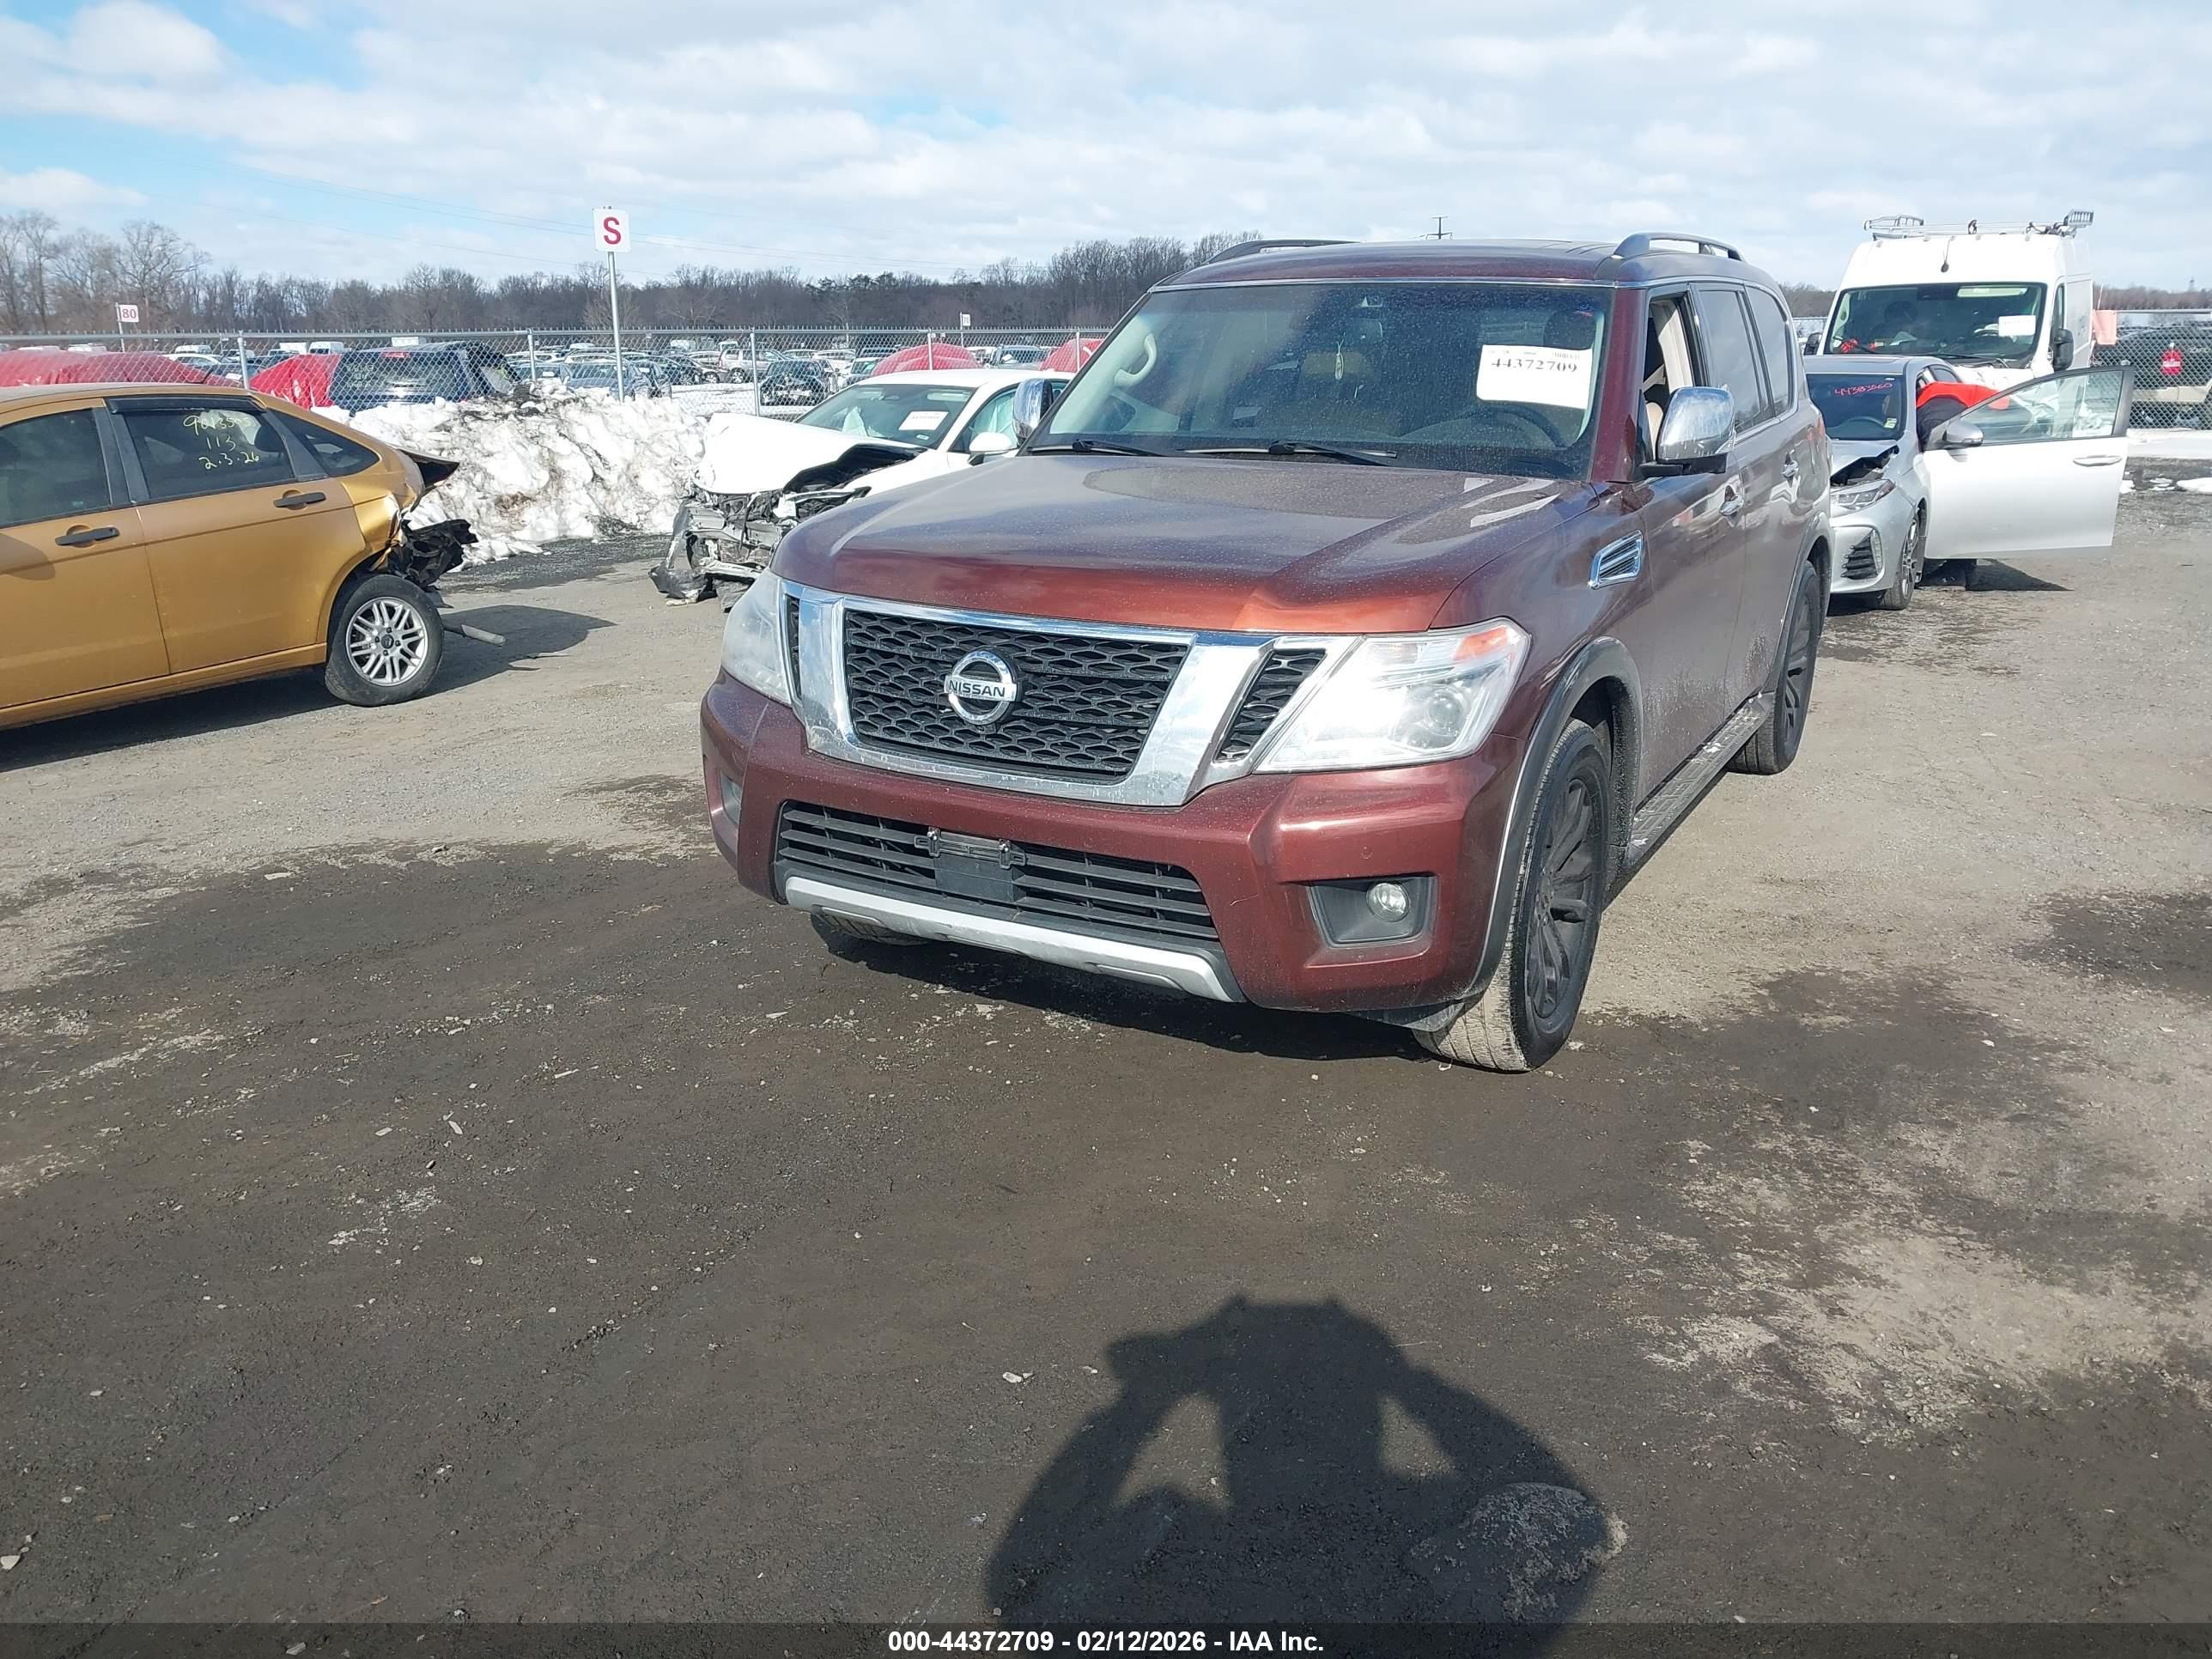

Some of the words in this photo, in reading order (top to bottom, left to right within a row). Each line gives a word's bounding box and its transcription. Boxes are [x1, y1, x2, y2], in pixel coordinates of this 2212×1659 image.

[604, 216, 621, 245] S
[122, 309, 137, 319] 80
[1492, 357, 1577, 372] 44372709
[206, 435, 236, 452] 113
[948, 679, 1006, 697] NISSAN
